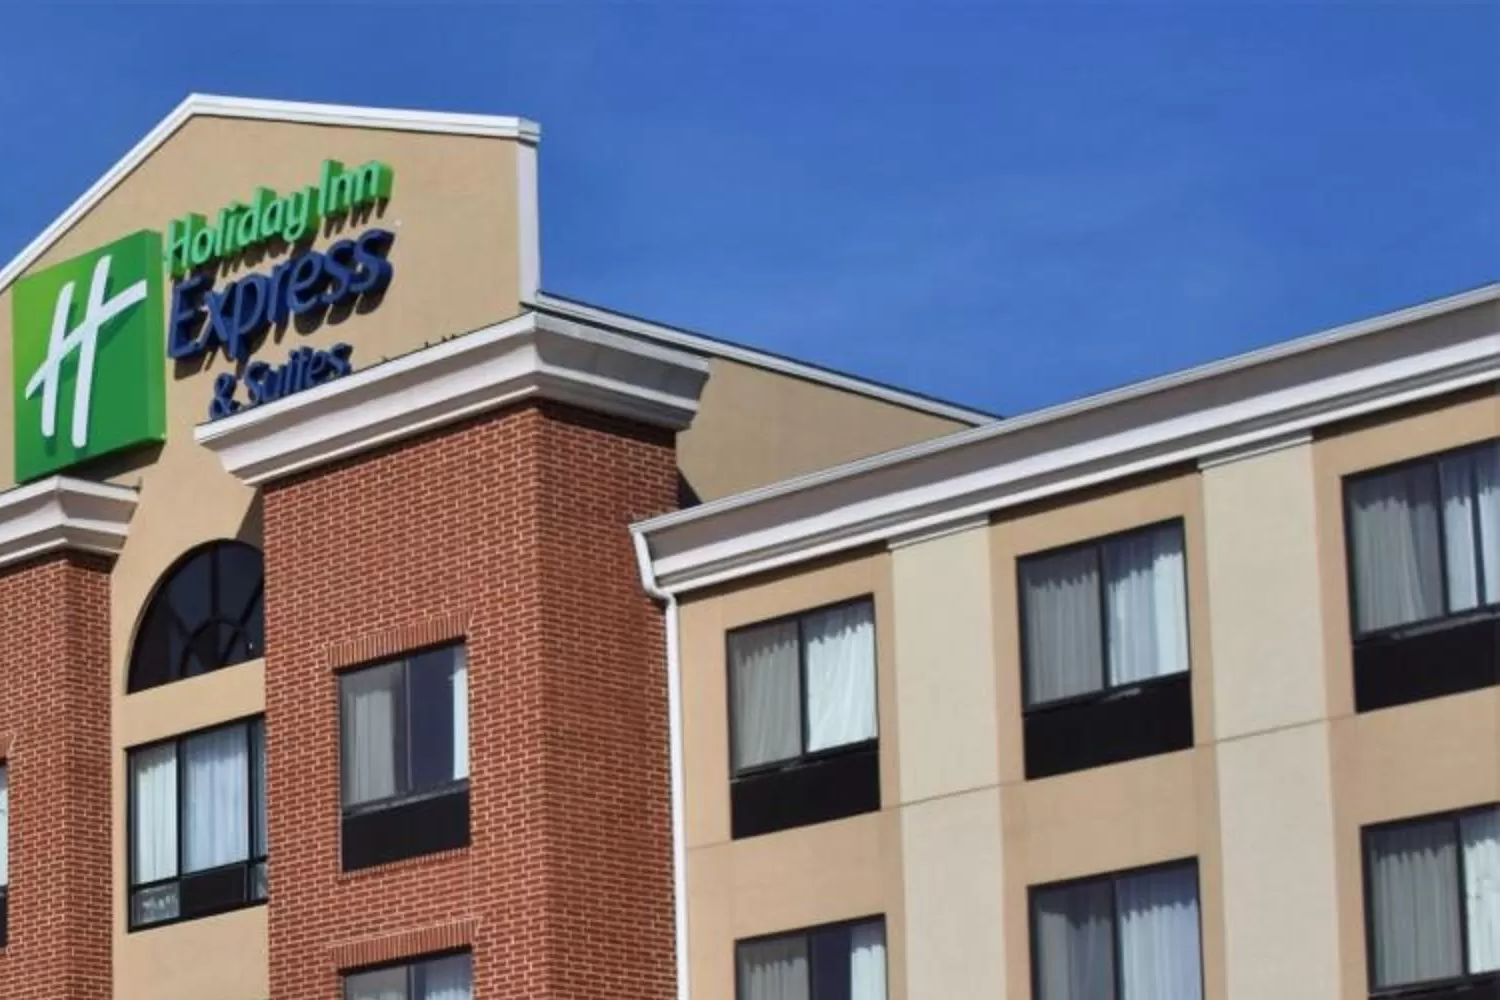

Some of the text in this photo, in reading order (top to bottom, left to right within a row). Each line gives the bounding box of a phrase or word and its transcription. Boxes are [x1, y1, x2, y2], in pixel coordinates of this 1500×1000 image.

[165, 159, 394, 280] Holiday Inn
[167, 228, 396, 360] Express
[209, 343, 353, 420] & Suites
